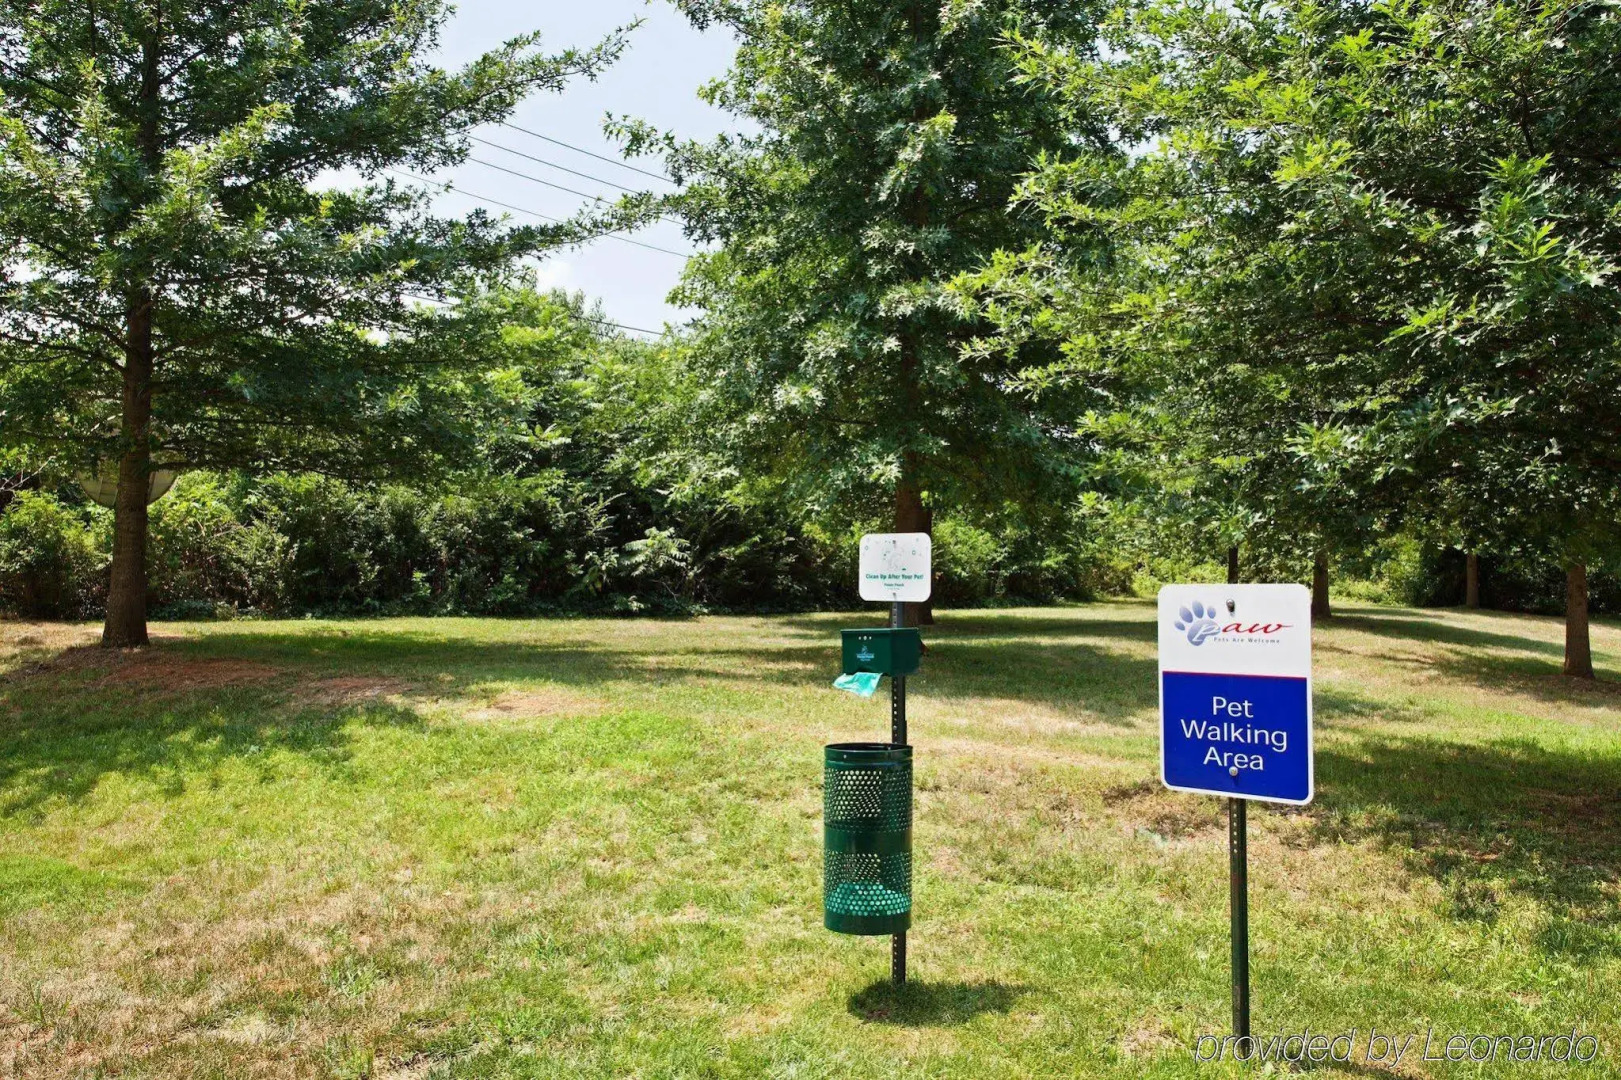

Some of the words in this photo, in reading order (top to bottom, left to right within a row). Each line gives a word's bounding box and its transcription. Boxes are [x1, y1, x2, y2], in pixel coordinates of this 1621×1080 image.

[1212, 696, 1254, 718] Pet
[1180, 718, 1288, 753] Walking
[1202, 746, 1264, 771] Area
